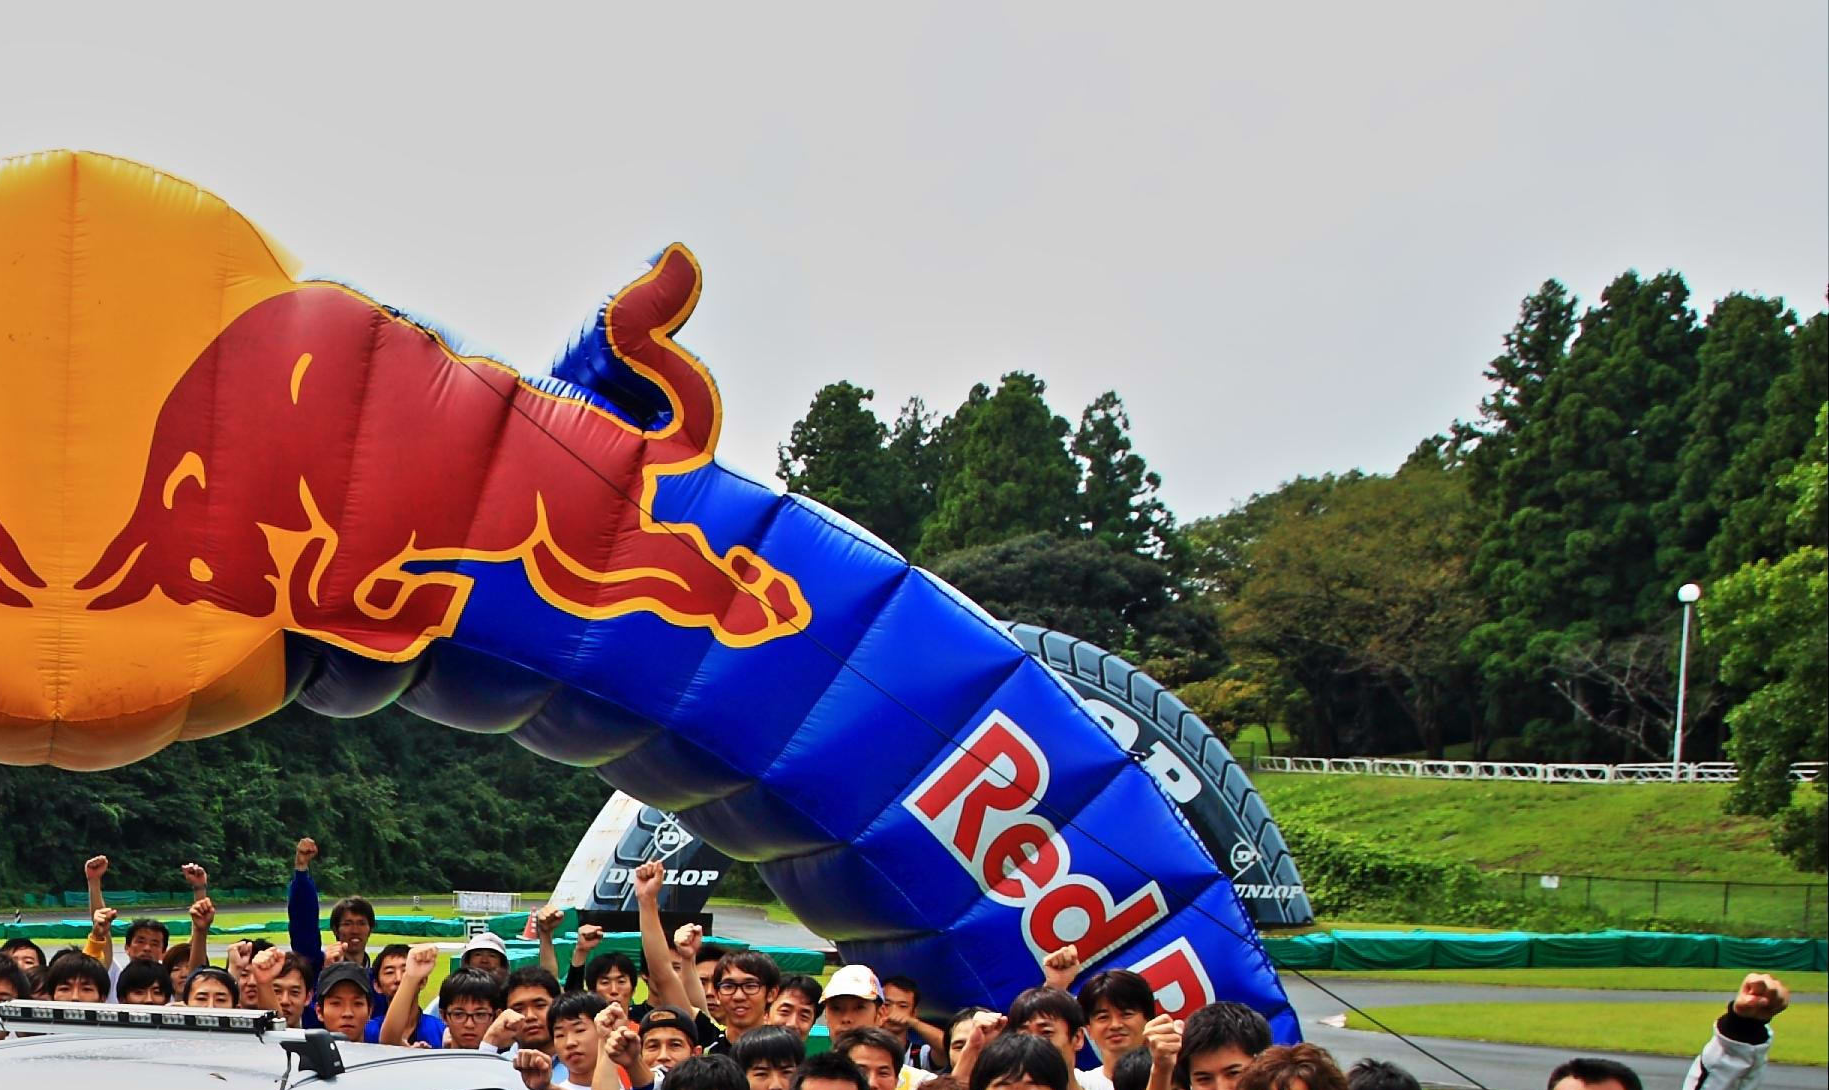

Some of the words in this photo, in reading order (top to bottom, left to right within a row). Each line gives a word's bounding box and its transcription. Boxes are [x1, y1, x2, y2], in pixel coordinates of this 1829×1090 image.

[908, 715, 1164, 970] Red
[606, 868, 719, 886] DLOP
[1232, 884, 1304, 900] UNLOP
